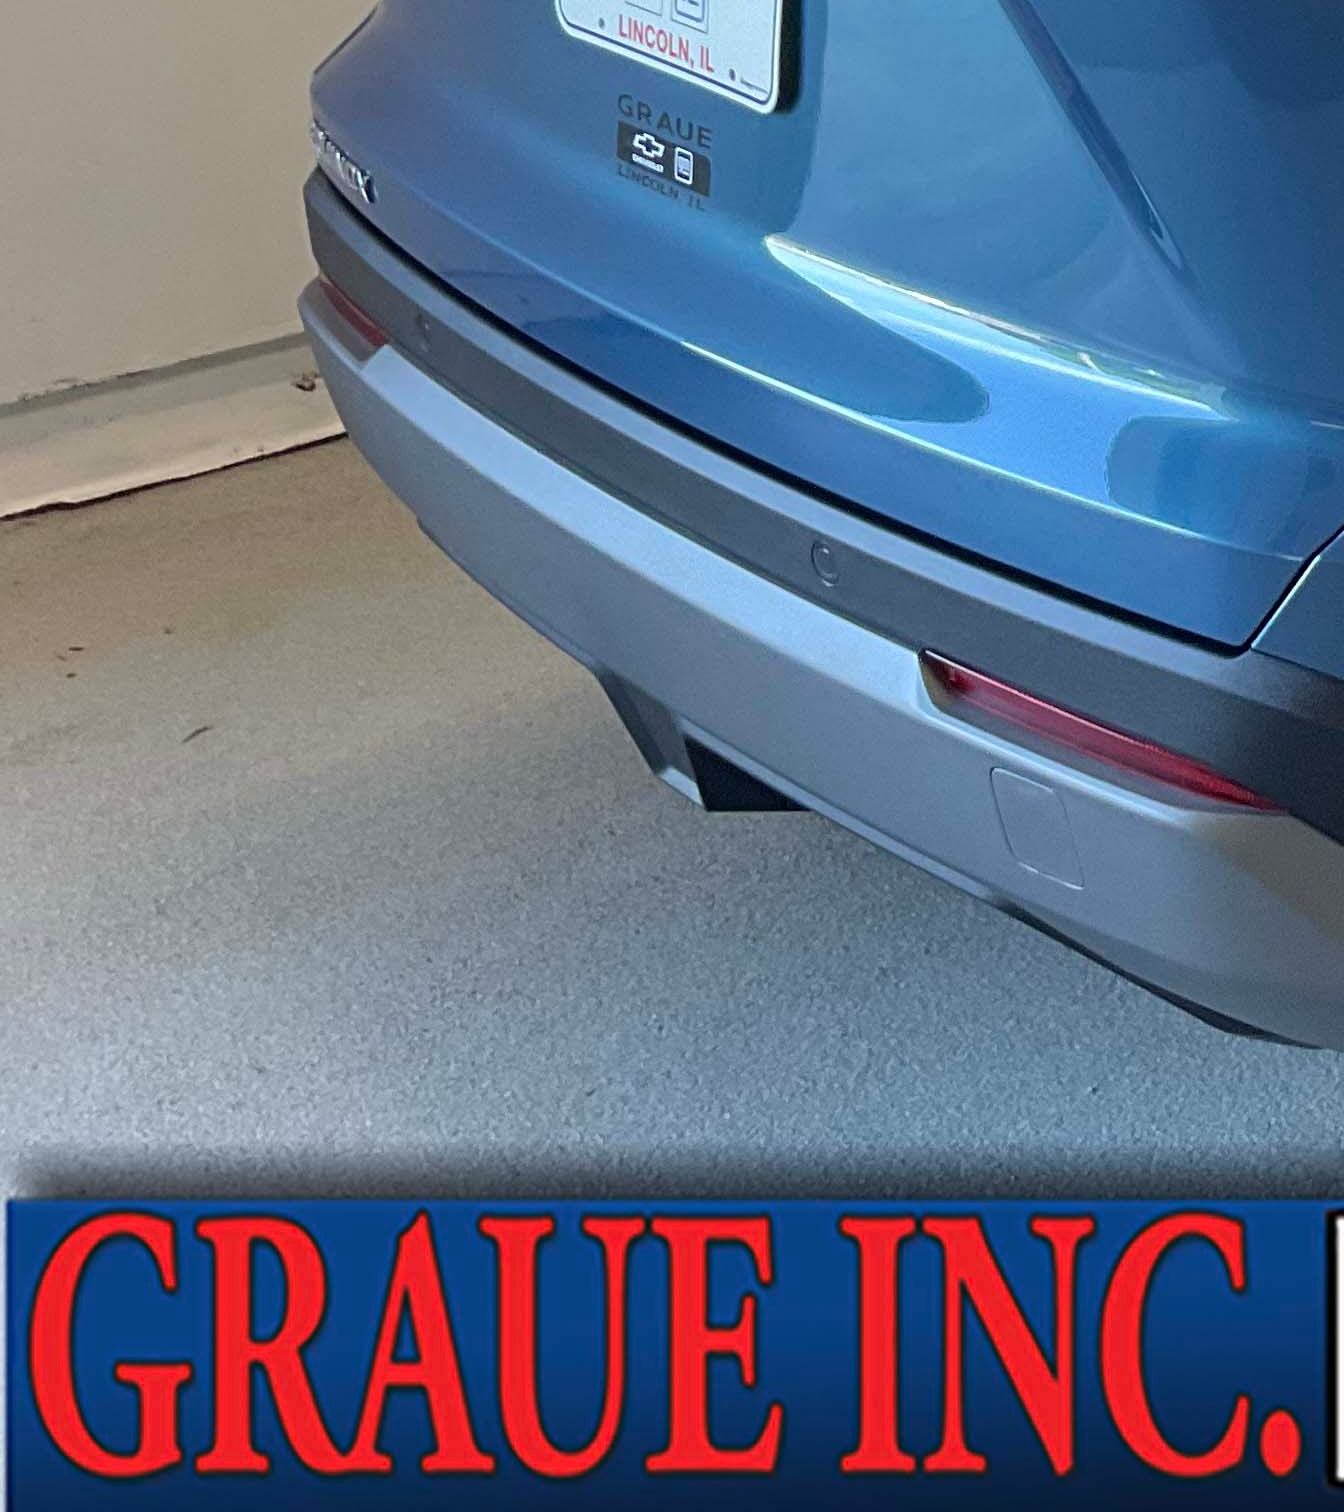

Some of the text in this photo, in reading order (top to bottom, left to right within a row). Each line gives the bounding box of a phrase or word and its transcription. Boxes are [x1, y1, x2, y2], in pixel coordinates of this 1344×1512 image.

[618, 14, 714, 73] LINCOLN, IL
[618, 94, 713, 150] GRAUE
